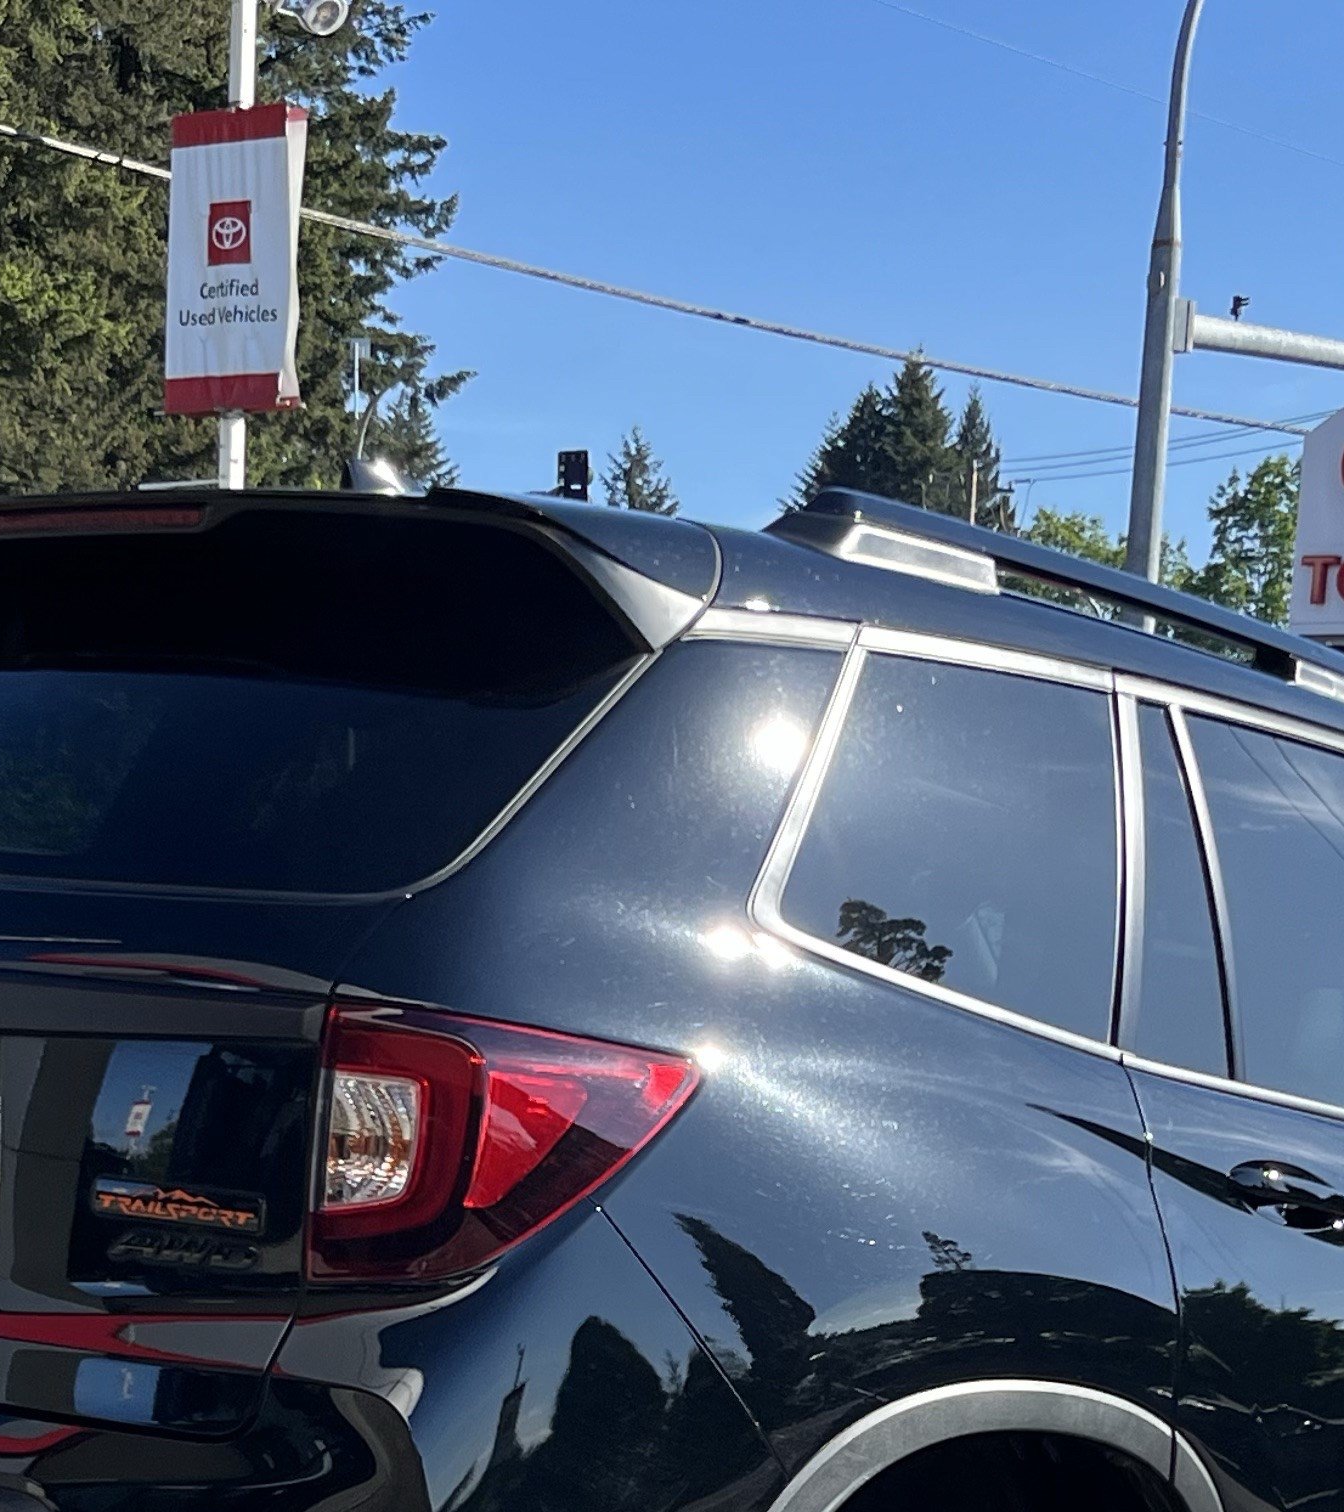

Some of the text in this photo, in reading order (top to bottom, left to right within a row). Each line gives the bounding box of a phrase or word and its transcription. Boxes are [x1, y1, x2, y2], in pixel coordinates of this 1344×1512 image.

[200, 278, 259, 299] Certified
[179, 304, 278, 327] Used Vehicles
[98, 1194, 255, 1229] TRAILSPORT
